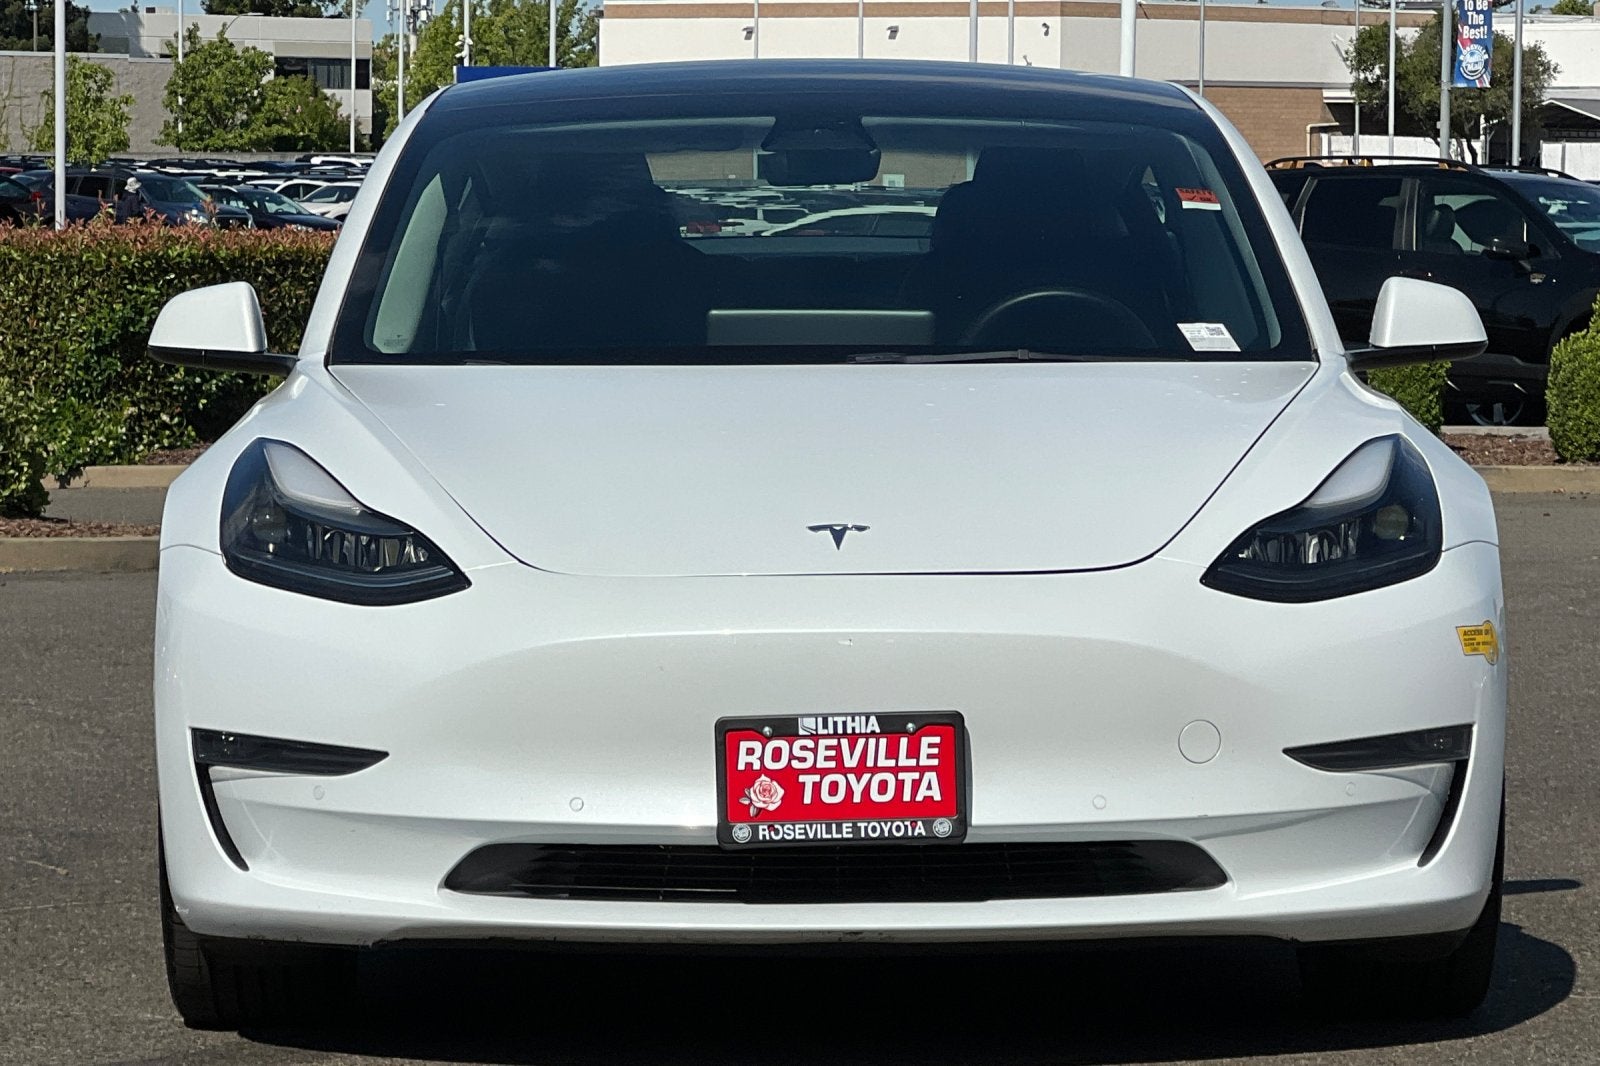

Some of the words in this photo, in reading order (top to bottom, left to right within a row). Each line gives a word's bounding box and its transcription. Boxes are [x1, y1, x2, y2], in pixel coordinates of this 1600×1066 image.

[1464, 0, 1474, 10] To
[1476, 0, 1489, 10] Be
[1467, 12, 1484, 25] The
[1463, 26, 1488, 39] Best!
[817, 715, 880, 735] LITHIA
[737, 736, 941, 771] ROSEVILLE
[798, 771, 942, 805] TOYOTA
[758, 823, 854, 841] ROSEVILLE
[857, 821, 926, 838] TOYOTA
